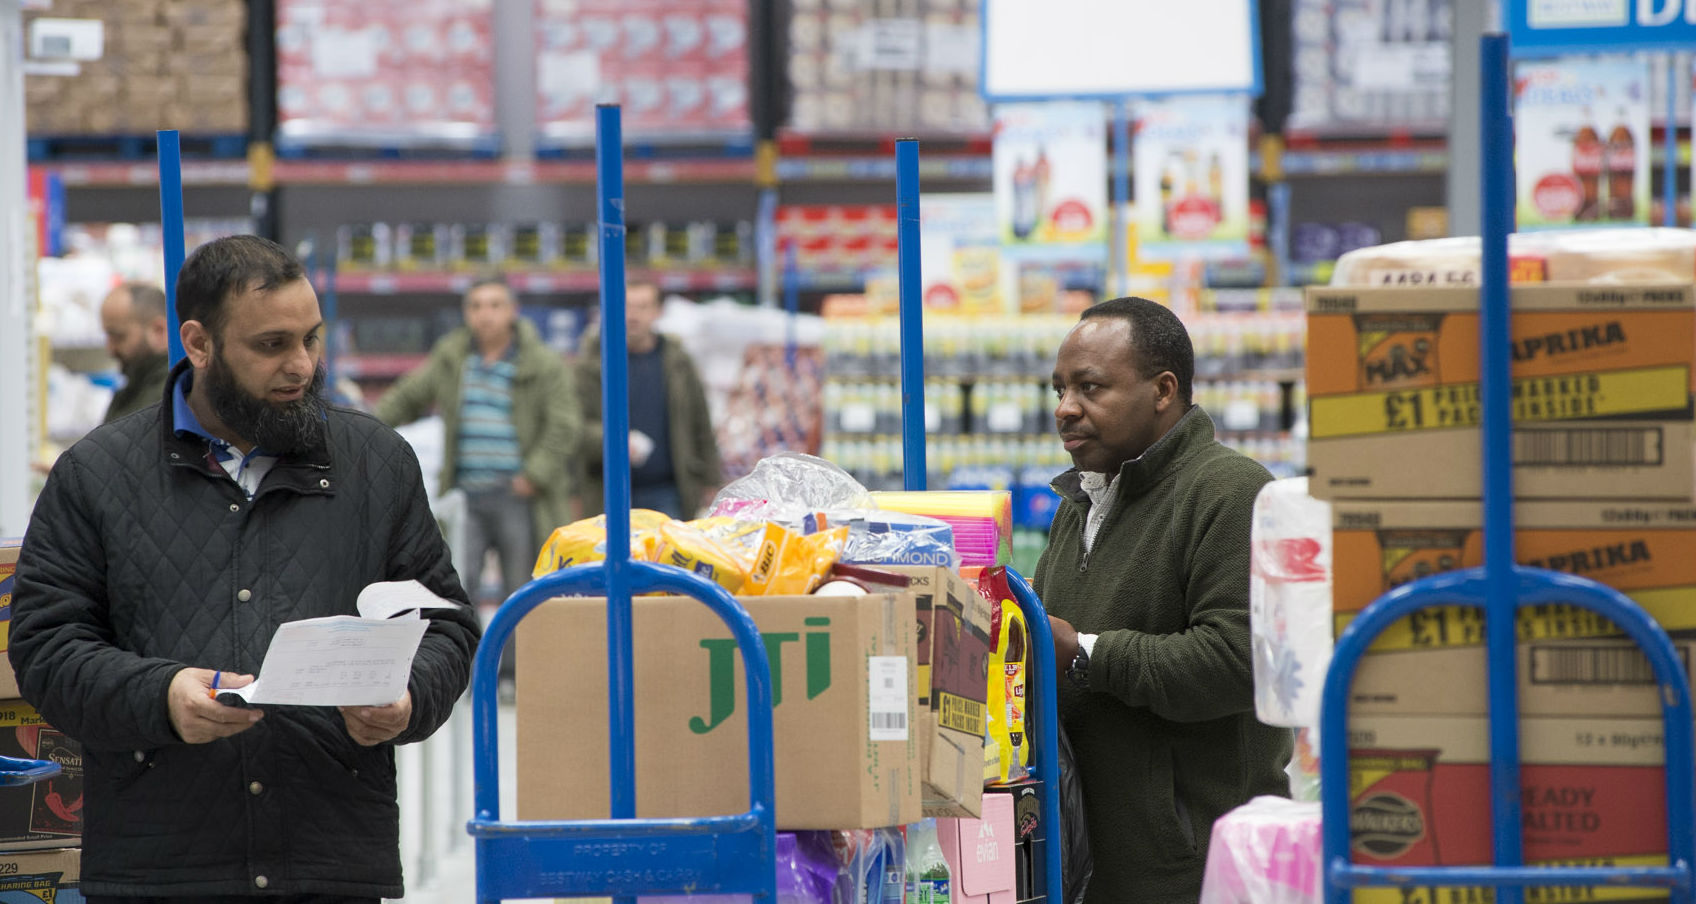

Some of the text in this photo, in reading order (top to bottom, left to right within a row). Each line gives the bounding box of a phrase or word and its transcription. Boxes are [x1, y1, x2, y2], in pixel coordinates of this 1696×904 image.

[1510, 321, 1627, 362] APRIKA
[1385, 392, 1424, 428] £1
[1438, 406, 1482, 426] PAC
[759, 541, 774, 576] BIC
[1528, 540, 1651, 571] PRIKA
[910, 576, 930, 586] CKS
[689, 616, 832, 735] JTi
[942, 694, 951, 726] £1
[1521, 786, 1596, 807] EADY
[1523, 811, 1601, 832] ALTED
[574, 843, 667, 857] PROPERTY OF
[976, 841, 998, 864] evian
[540, 871, 602, 885] BESTWAY
[607, 870, 640, 883] CASH
